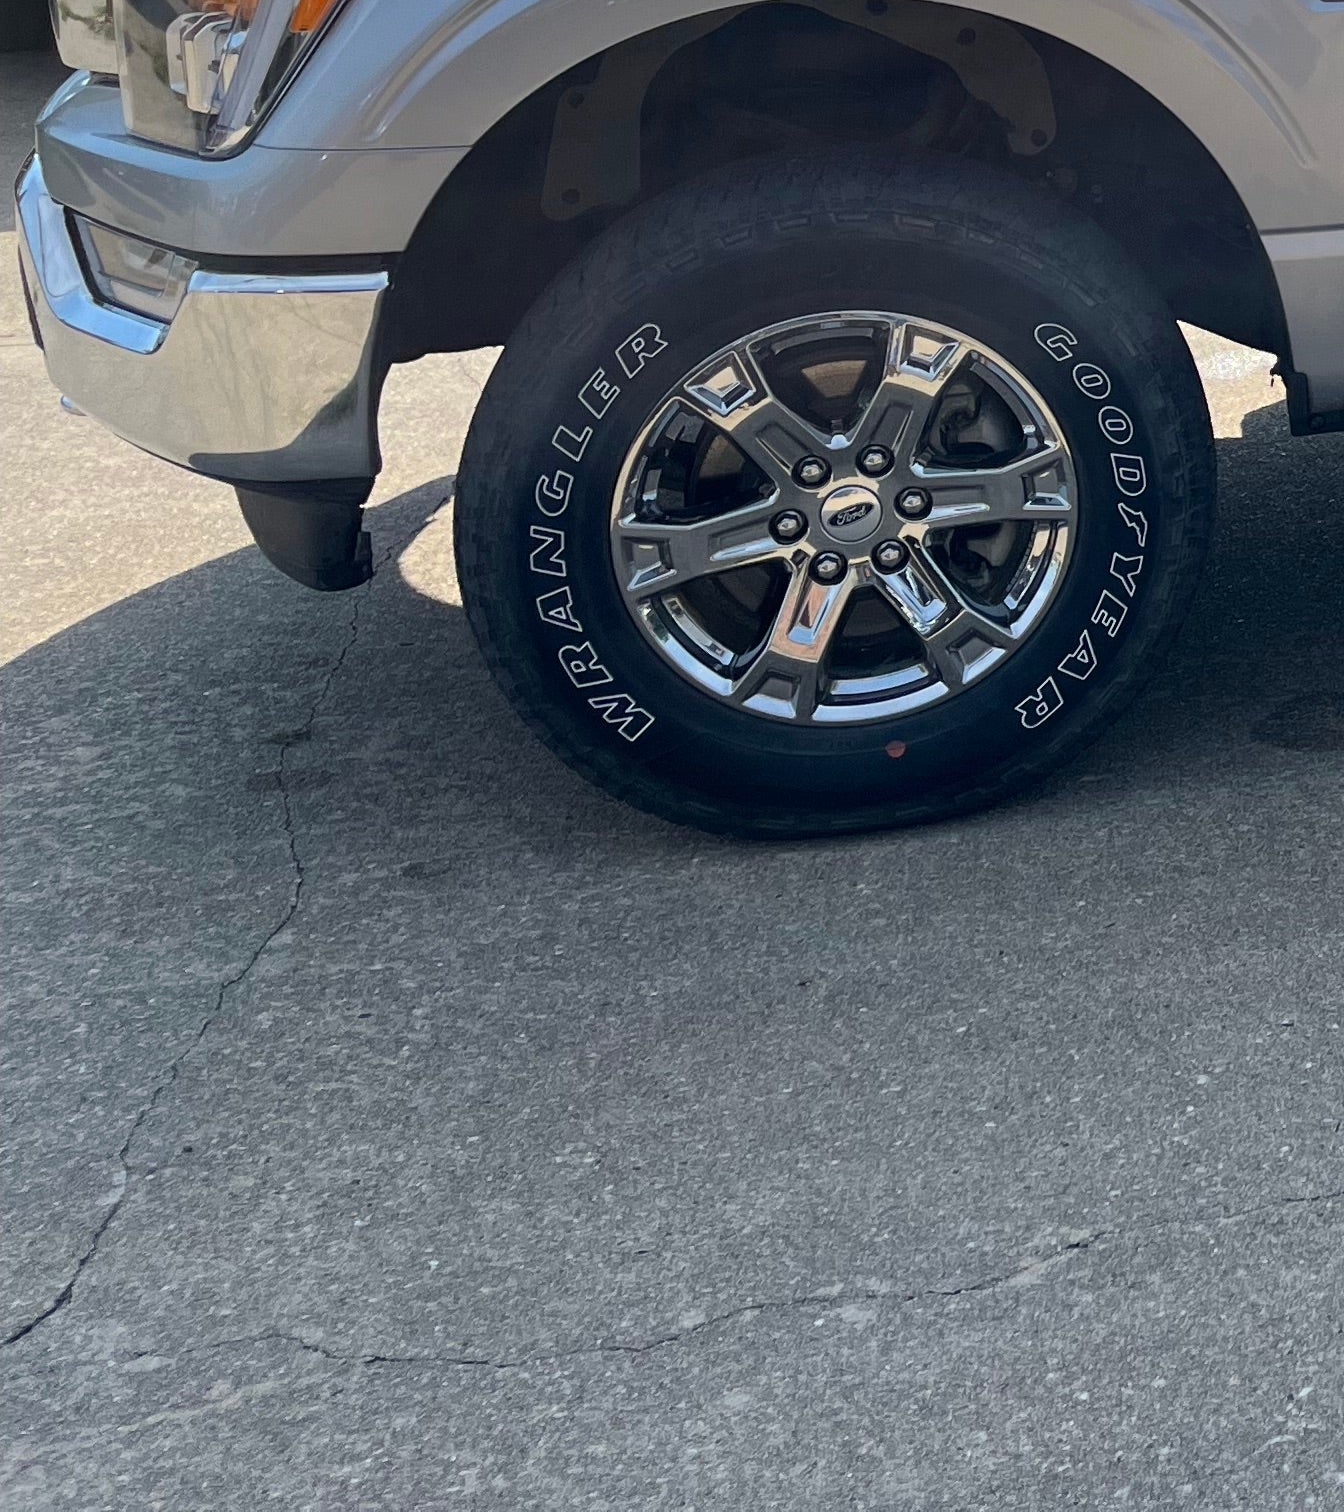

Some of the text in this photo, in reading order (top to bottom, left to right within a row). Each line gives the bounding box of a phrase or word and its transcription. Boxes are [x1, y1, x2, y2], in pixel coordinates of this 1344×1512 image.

[530, 323, 668, 742] WRANGLER
[836, 504, 867, 525] Ford
[1014, 323, 1148, 728] GOODYEAR
